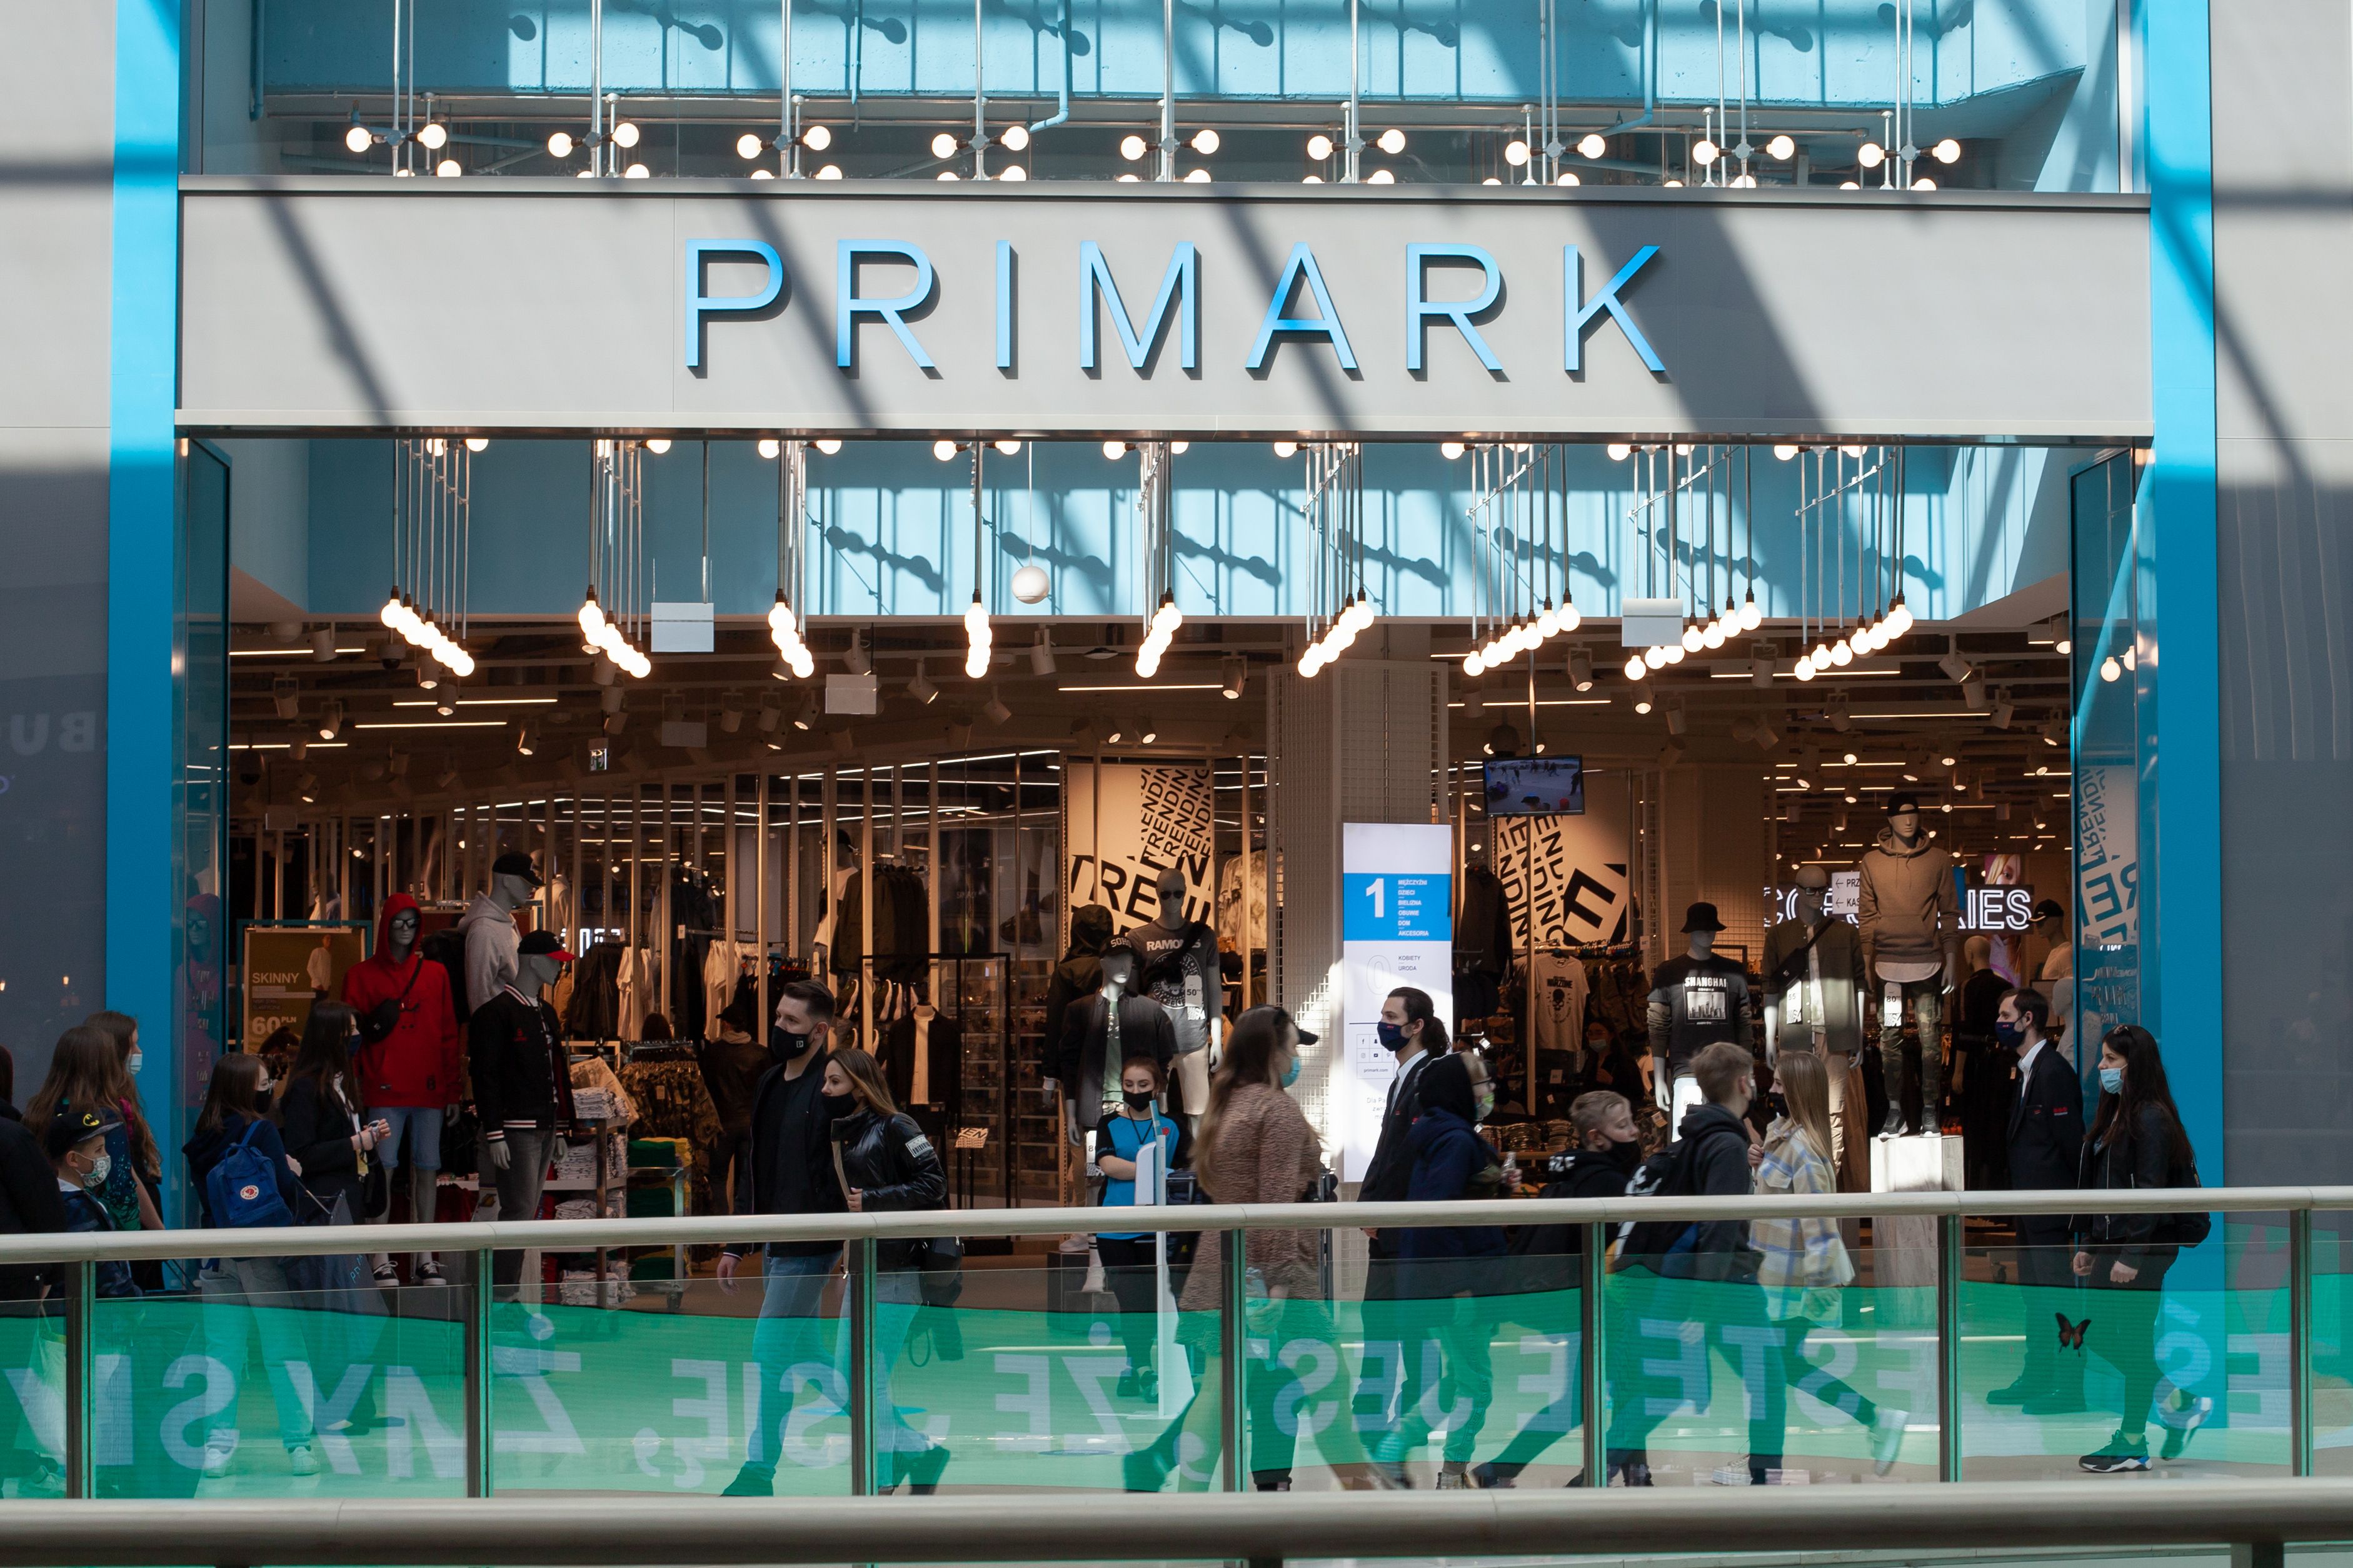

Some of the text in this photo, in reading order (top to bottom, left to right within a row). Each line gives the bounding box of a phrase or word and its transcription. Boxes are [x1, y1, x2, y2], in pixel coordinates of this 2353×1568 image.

[685, 237, 1665, 374] PRIMARK
[1847, 878, 1860, 887] PRZ
[1366, 878, 1384, 918] 1
[1847, 898, 1860, 906] KAS
[252, 972, 300, 984] SKINNY
[1684, 977, 1727, 987] SHANGHAI
